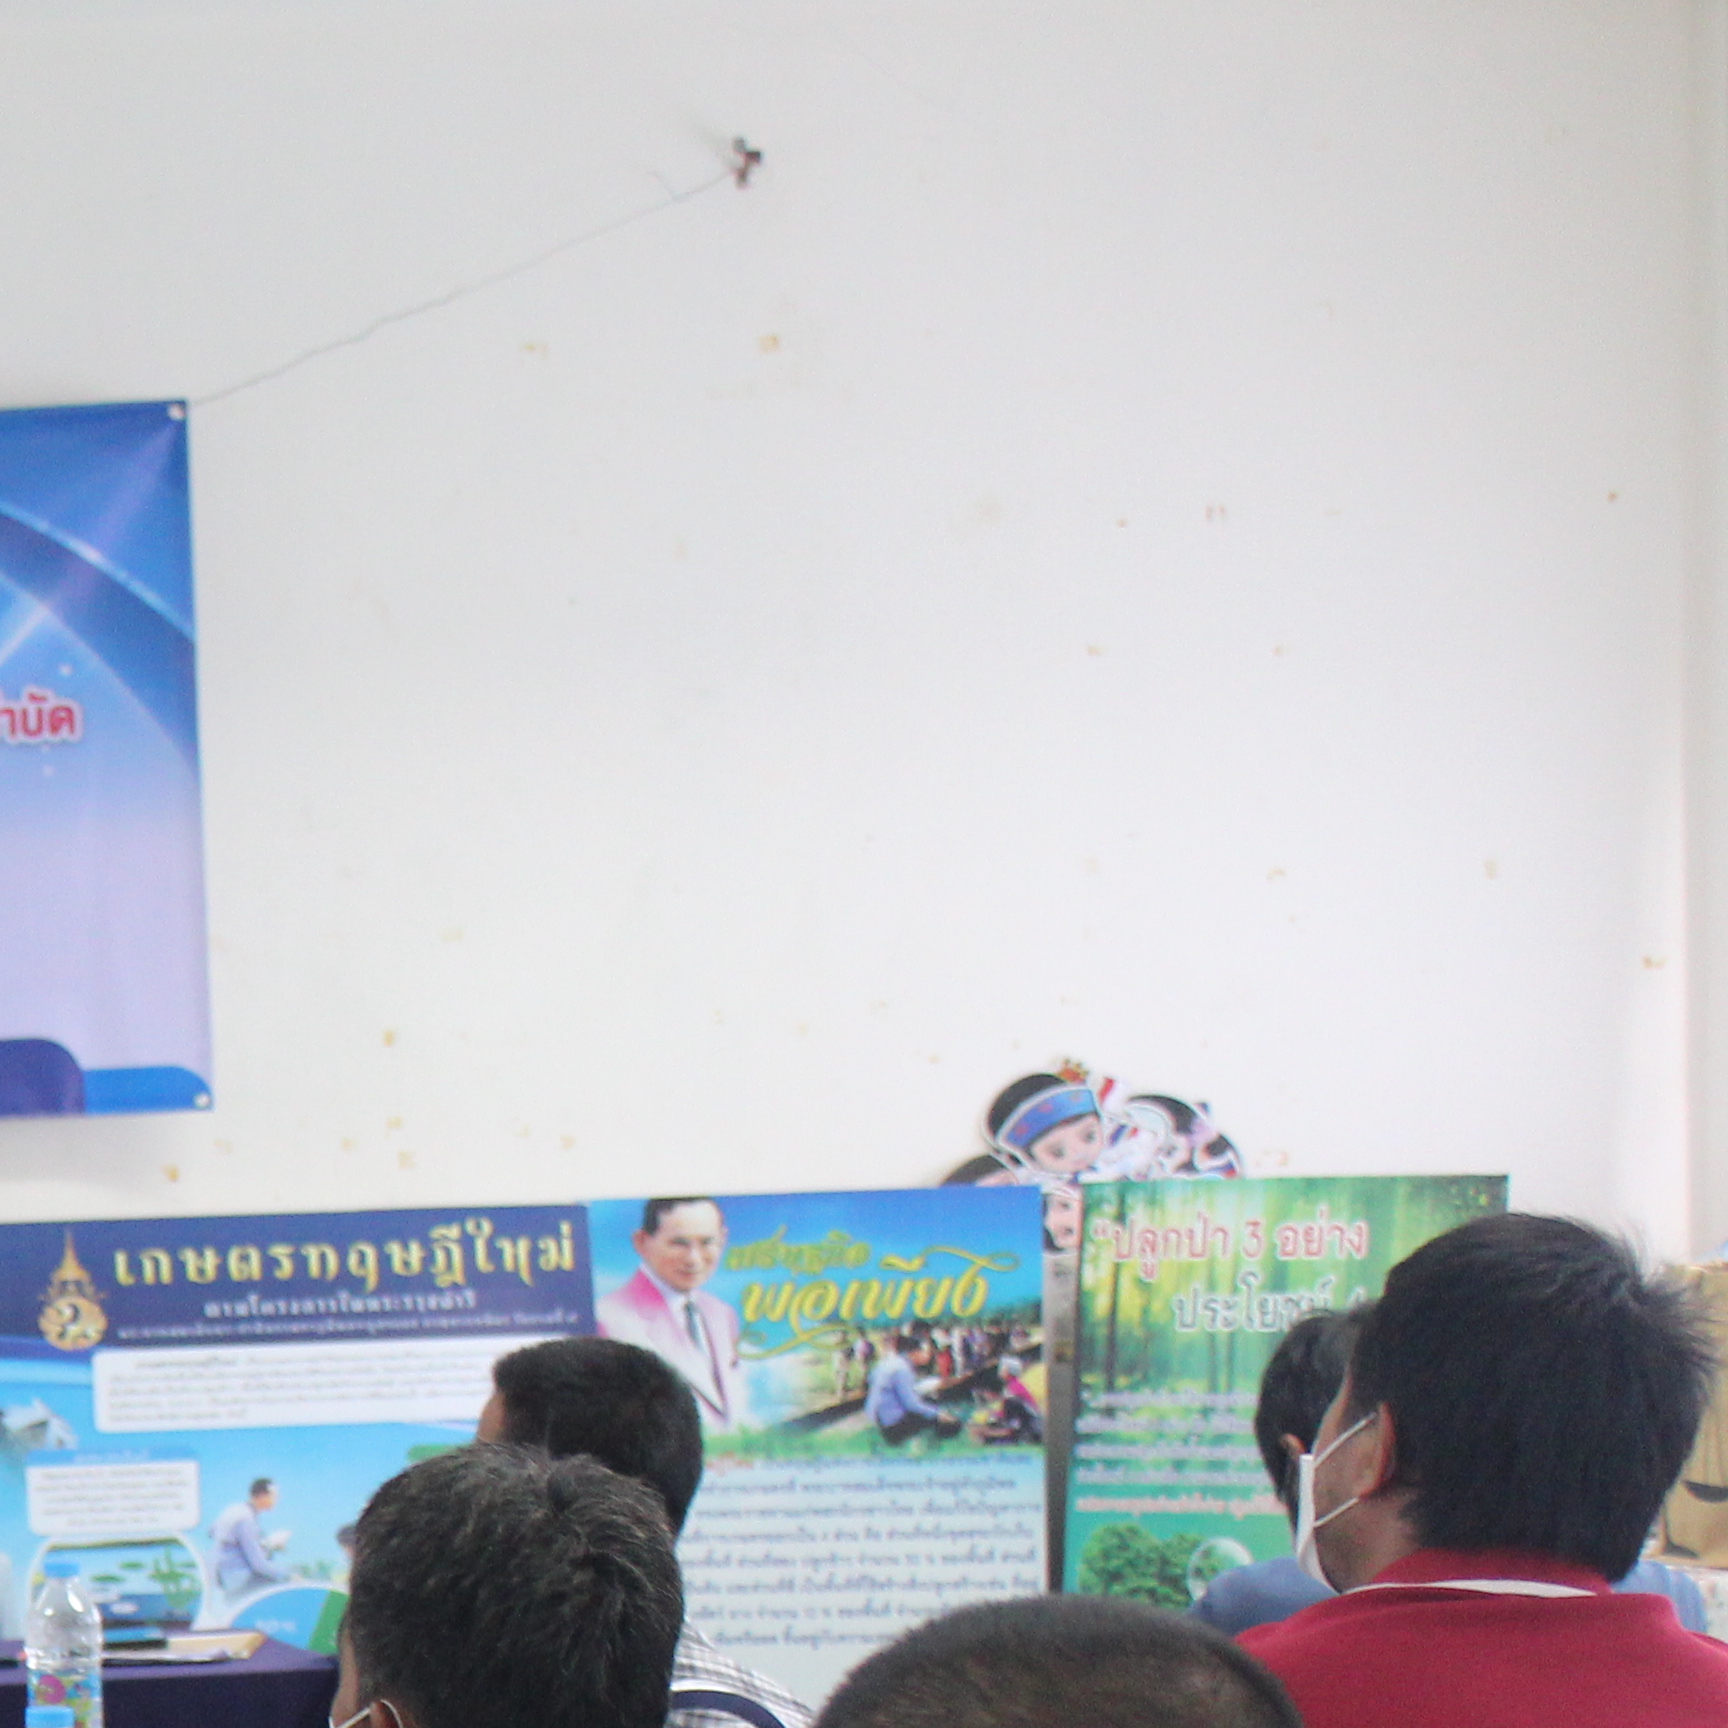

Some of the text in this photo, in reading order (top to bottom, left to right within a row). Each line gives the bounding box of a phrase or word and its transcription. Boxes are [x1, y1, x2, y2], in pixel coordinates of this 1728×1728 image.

[114, 1217, 576, 1292] เกษตรทฤษฎีใหม่
[1243, 1219, 1264, 1259] 3
[1275, 1204, 1368, 1259] อย่าง
[737, 1245, 1020, 1360] พอเพียง
